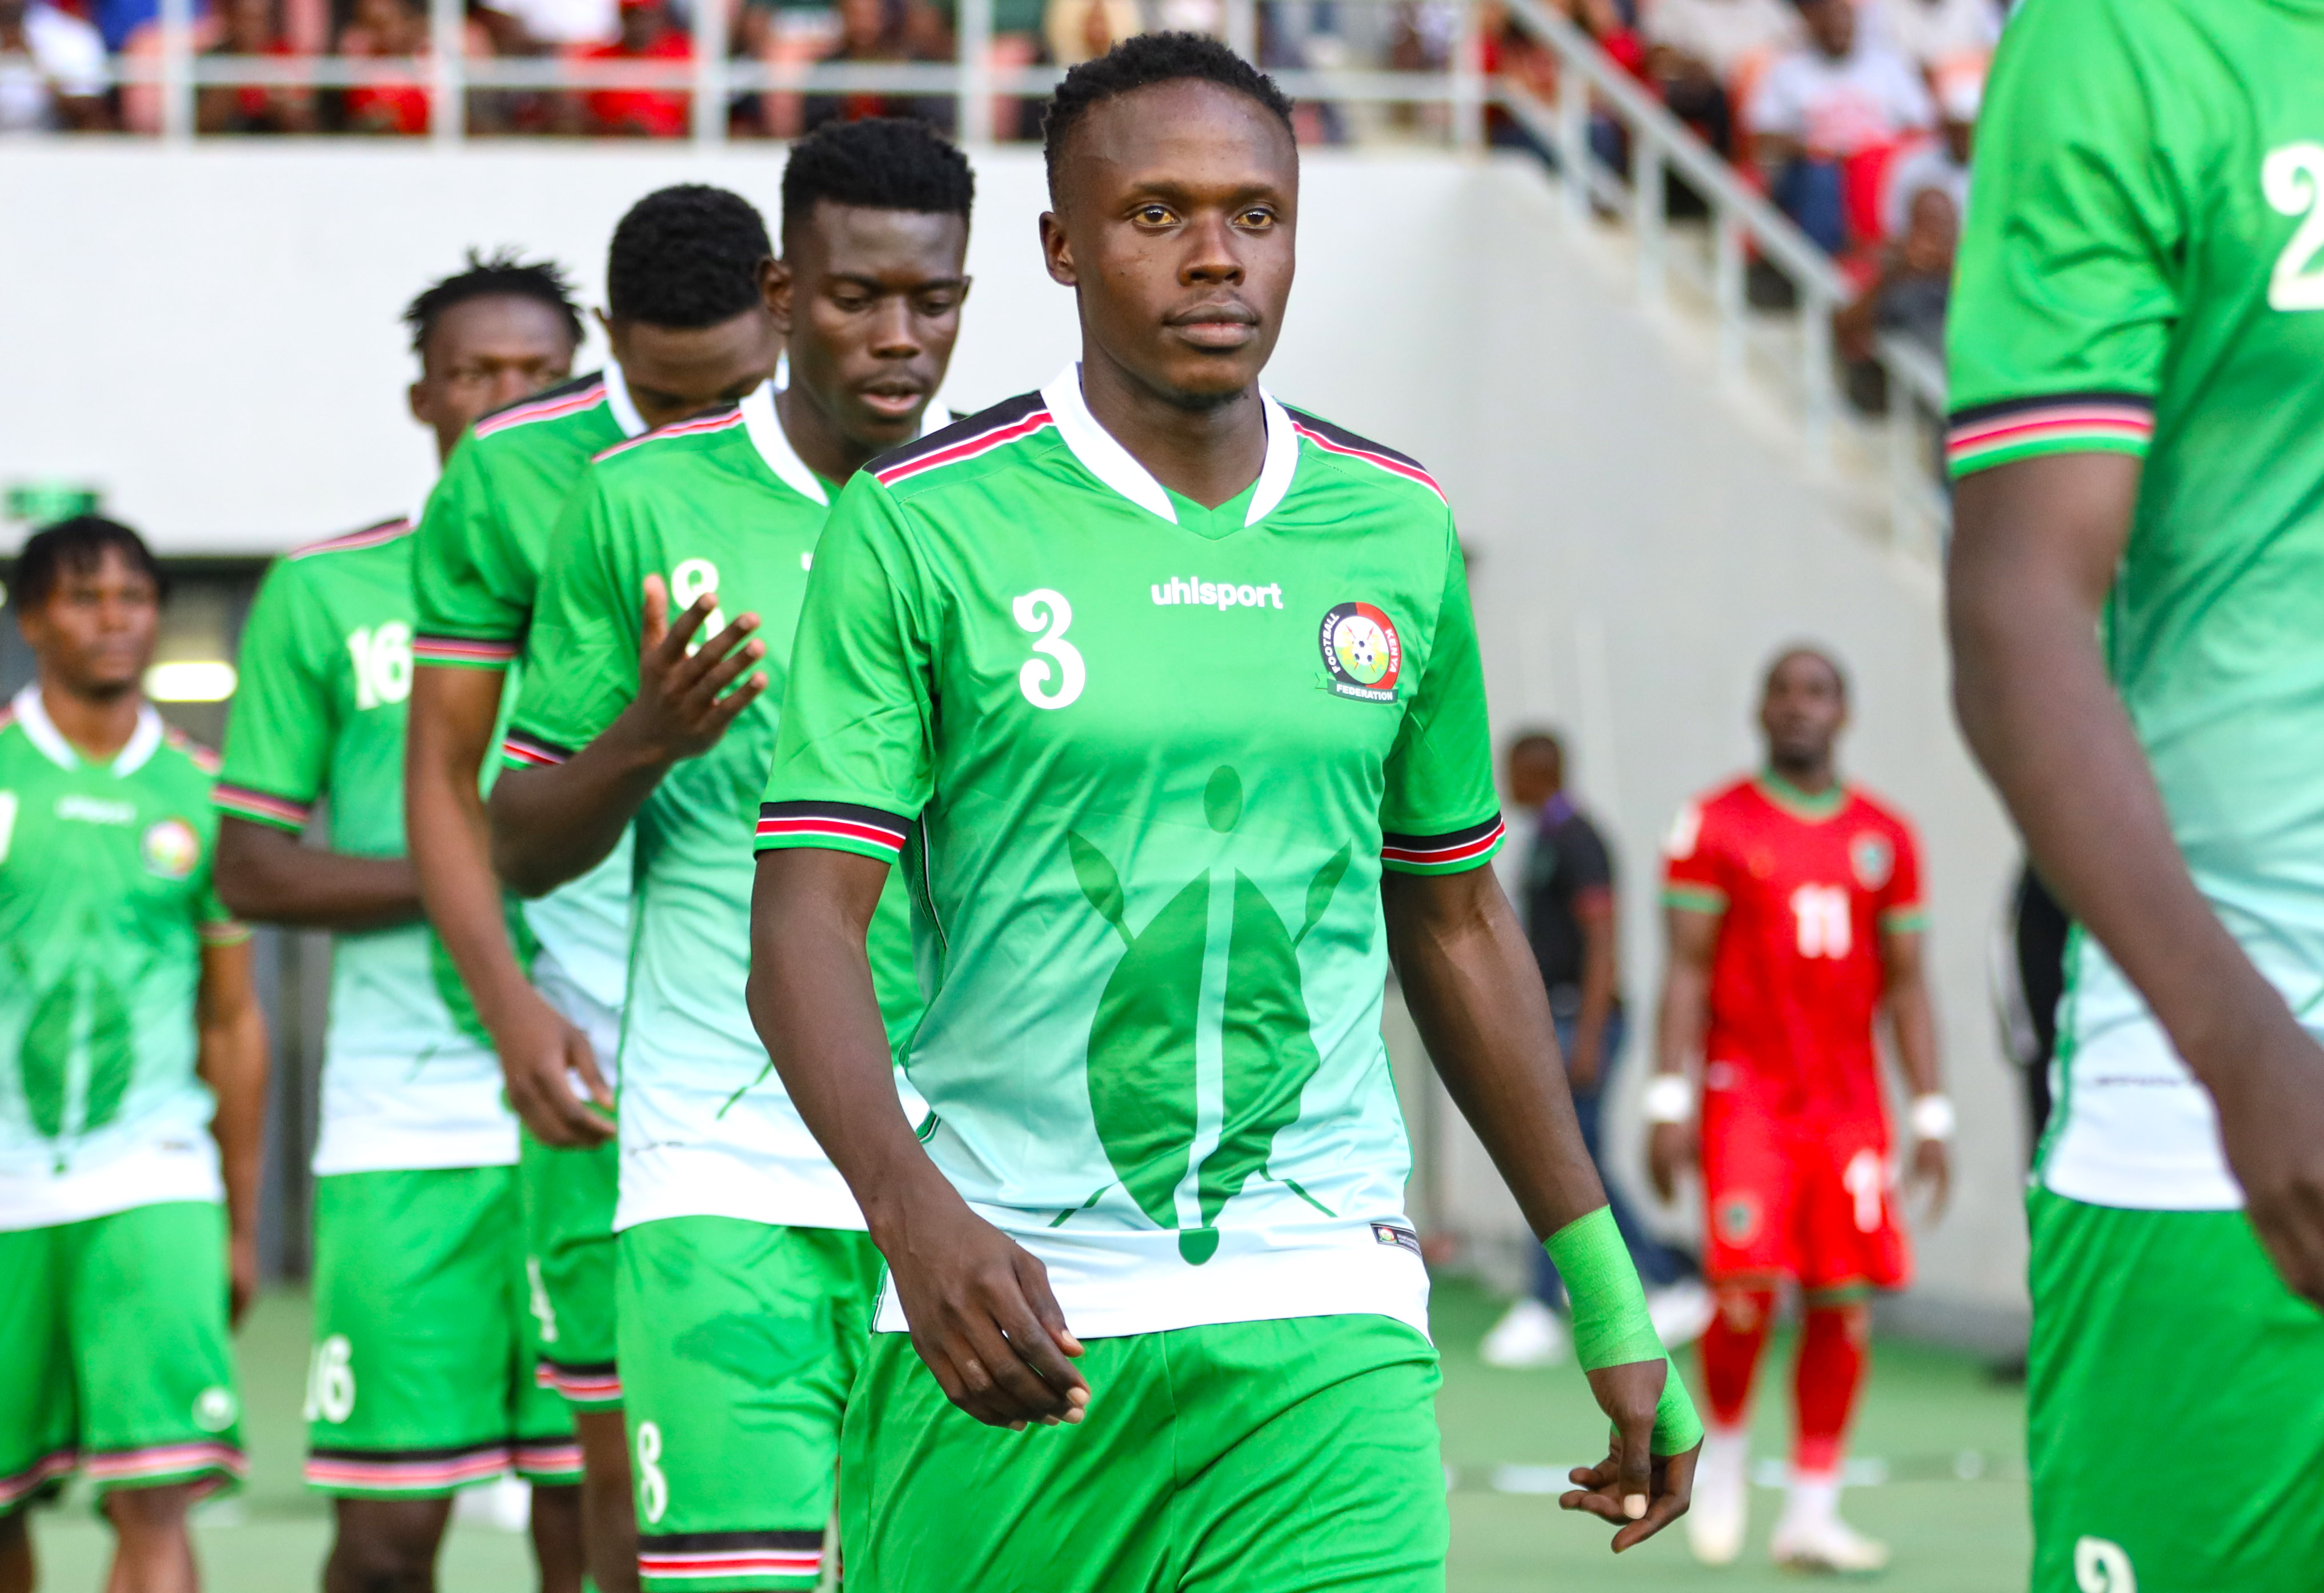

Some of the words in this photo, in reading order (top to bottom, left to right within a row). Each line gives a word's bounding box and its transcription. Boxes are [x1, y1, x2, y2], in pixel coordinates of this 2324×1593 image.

[1151, 577, 1283, 611] uhlsport
[346, 619, 414, 711] 16
[1013, 589, 1085, 709] 3
[1323, 613, 1341, 674] FOOTBALL
[1385, 629, 1399, 673] KENYA
[1336, 683, 1393, 701] FEDERATION
[1789, 883, 1852, 960] 11
[637, 1420, 668, 1524] 8
